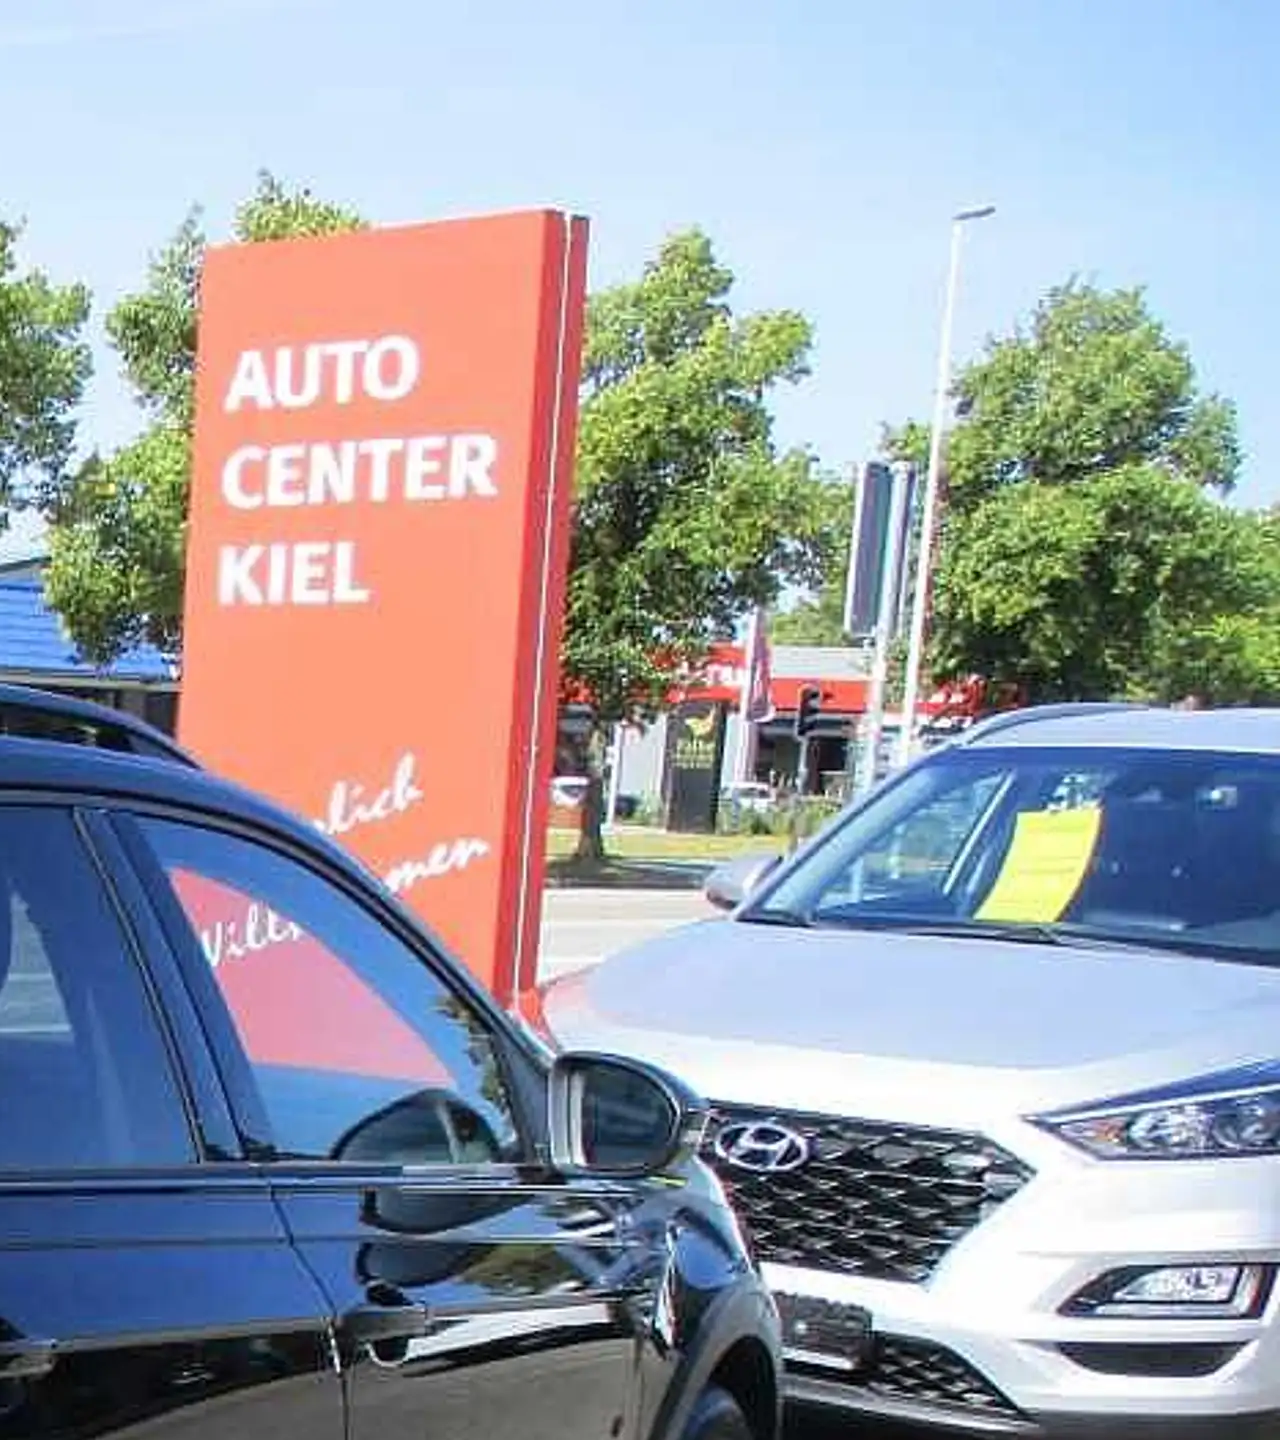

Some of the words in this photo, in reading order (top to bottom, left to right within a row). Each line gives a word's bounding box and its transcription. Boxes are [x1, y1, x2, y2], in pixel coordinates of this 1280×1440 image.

[223, 334, 421, 412] AUTO
[221, 432, 498, 510] CENTER
[217, 540, 371, 606] KIEL
